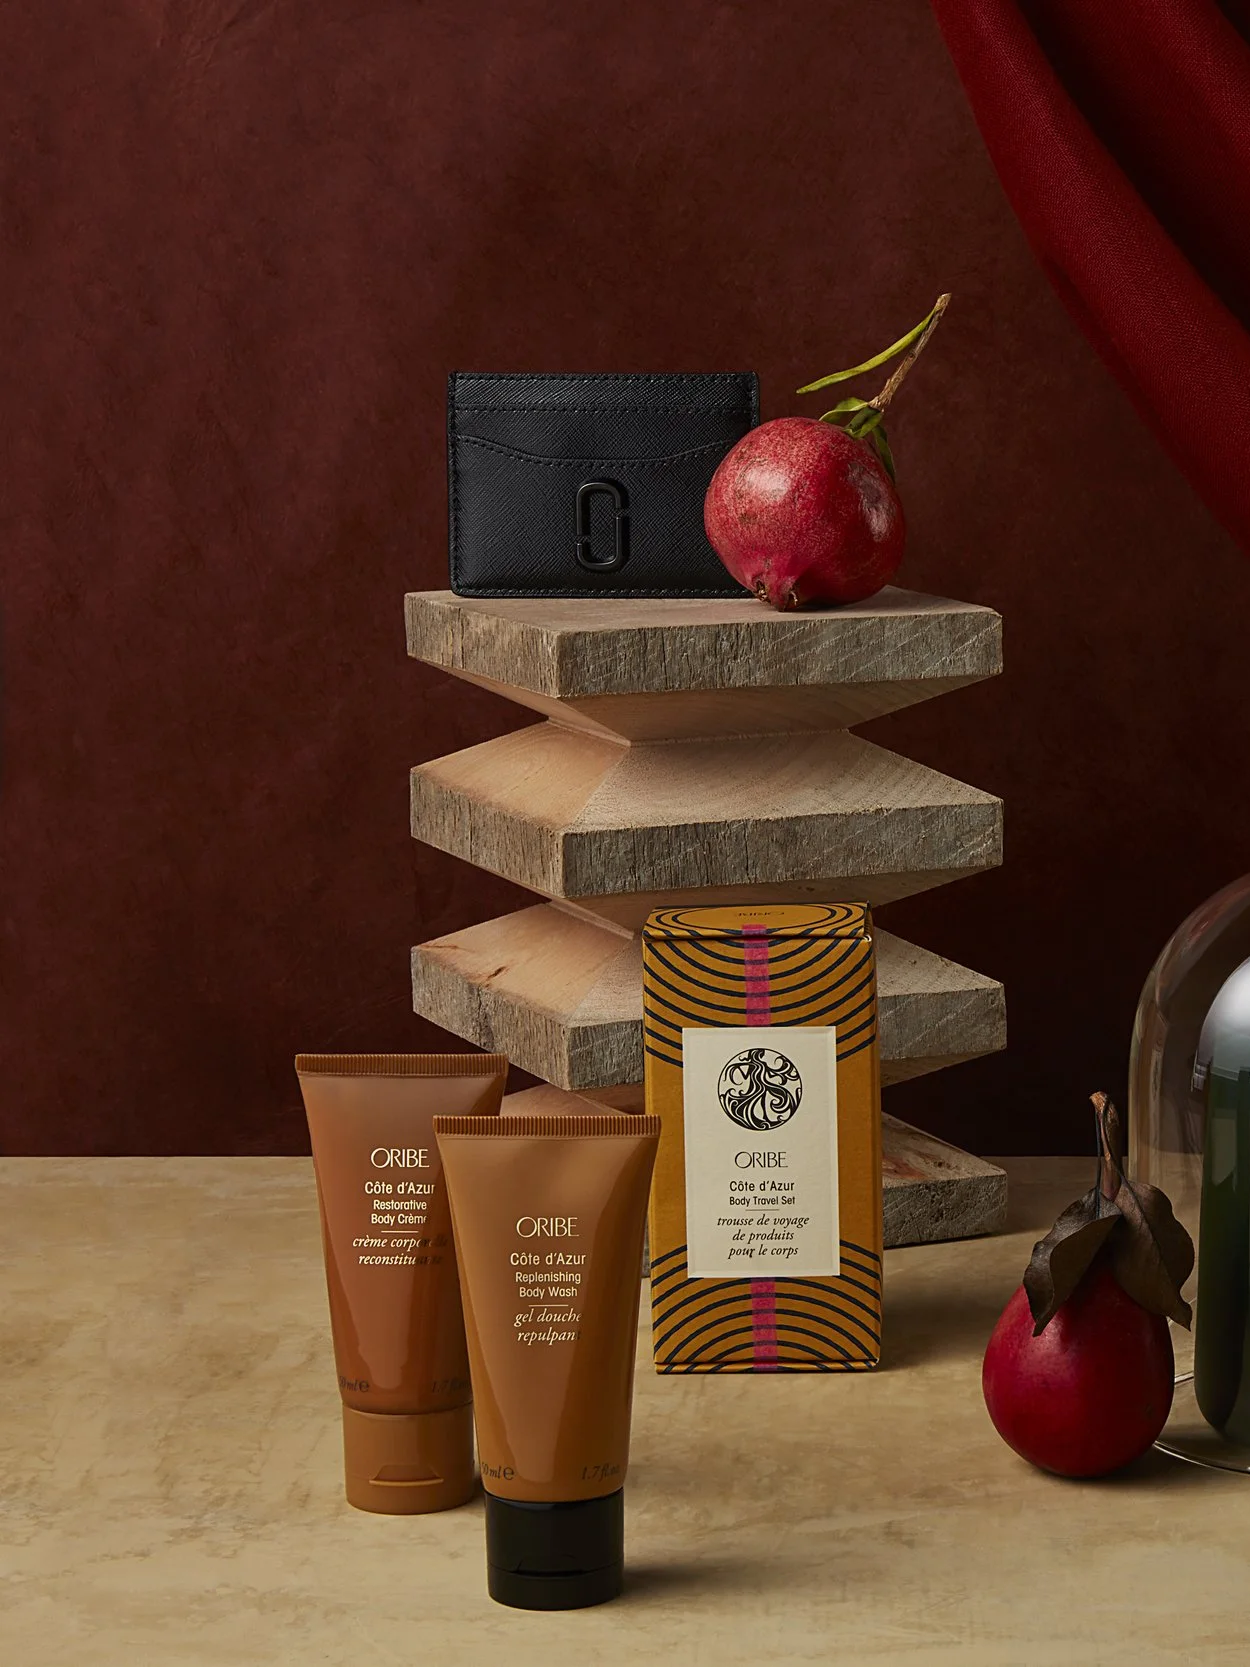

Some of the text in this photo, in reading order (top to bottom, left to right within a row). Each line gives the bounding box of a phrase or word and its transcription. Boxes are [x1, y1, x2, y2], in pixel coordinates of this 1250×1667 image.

[370, 1147, 430, 1168] ORIBE
[735, 1151, 788, 1169] ORIBE
[364, 1181, 393, 1195] Côte
[729, 1180, 795, 1192] Côte d'Azur
[373, 1199, 427, 1210] Restorative
[729, 1195, 796, 1207] Body Travel Set
[371, 1213, 395, 1226] Body
[717, 1213, 810, 1229] trousse de voyage
[516, 1216, 580, 1238] ORIBE
[352, 1235, 388, 1248] crème
[732, 1228, 795, 1245] de produits
[727, 1243, 799, 1260] pour le corps
[510, 1252, 586, 1266] Côte d'Azur
[515, 1271, 581, 1284] Replenishing
[519, 1286, 578, 1299] Body Wash
[513, 1308, 581, 1328] gel douche
[517, 1326, 580, 1346] repulpan
